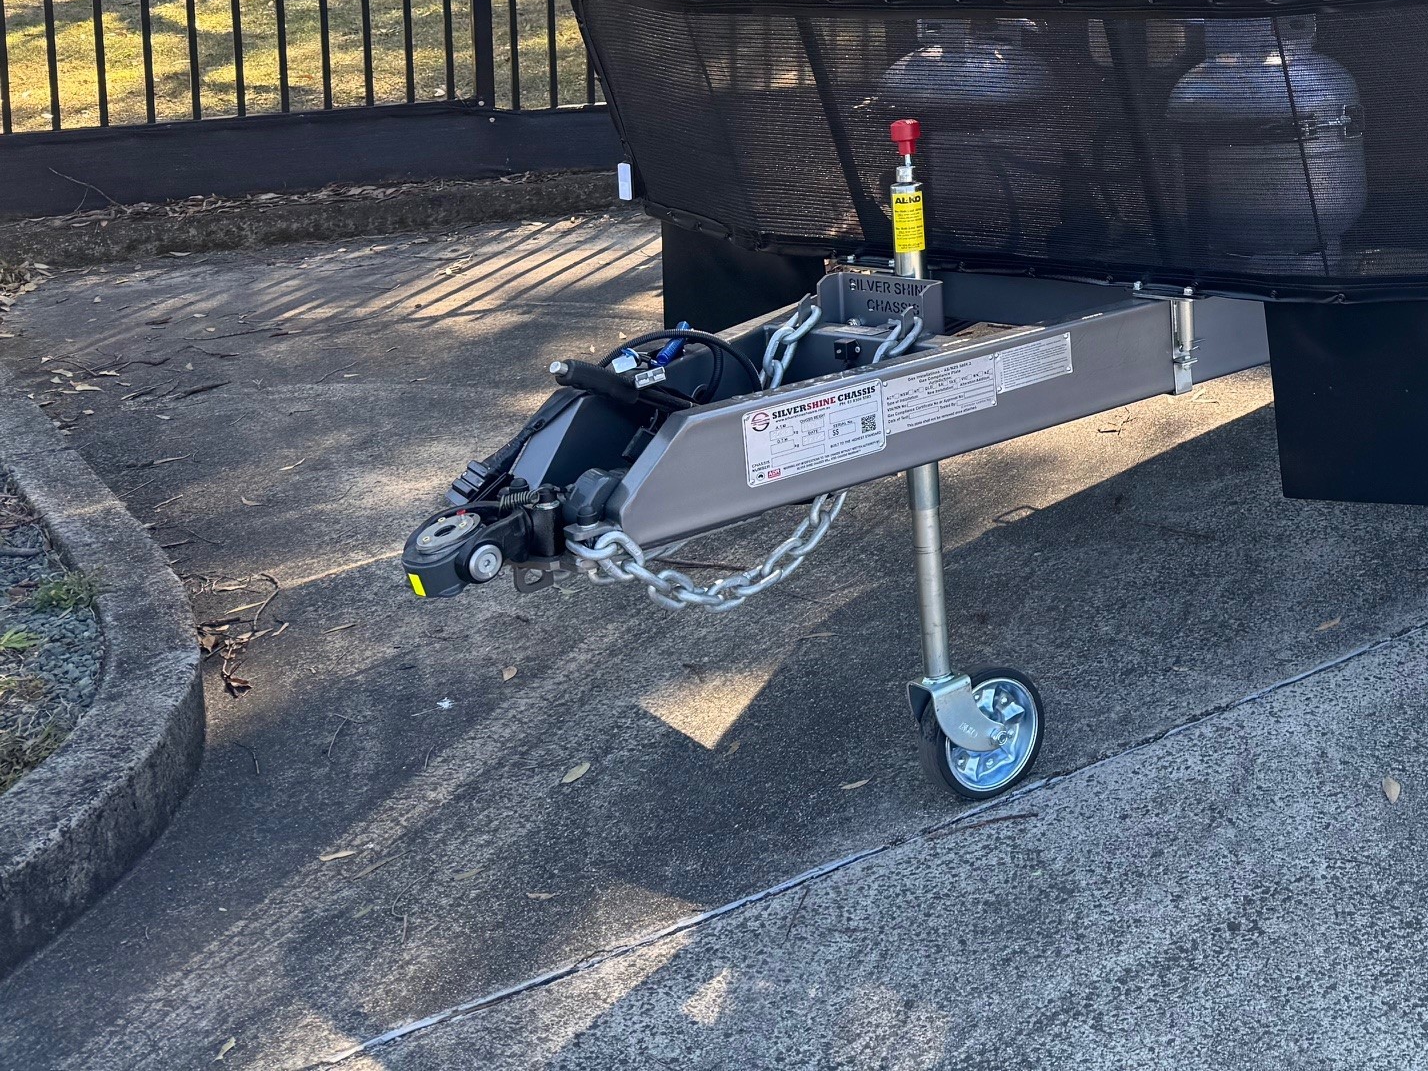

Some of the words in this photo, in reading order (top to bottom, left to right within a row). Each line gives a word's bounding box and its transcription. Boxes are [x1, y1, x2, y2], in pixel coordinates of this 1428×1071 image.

[849, 278, 891, 294] SILVER
[866, 298, 920, 316] CHASSS
[772, 396, 835, 419] SILVERSHINE
[837, 385, 875, 401] CHASSIS
